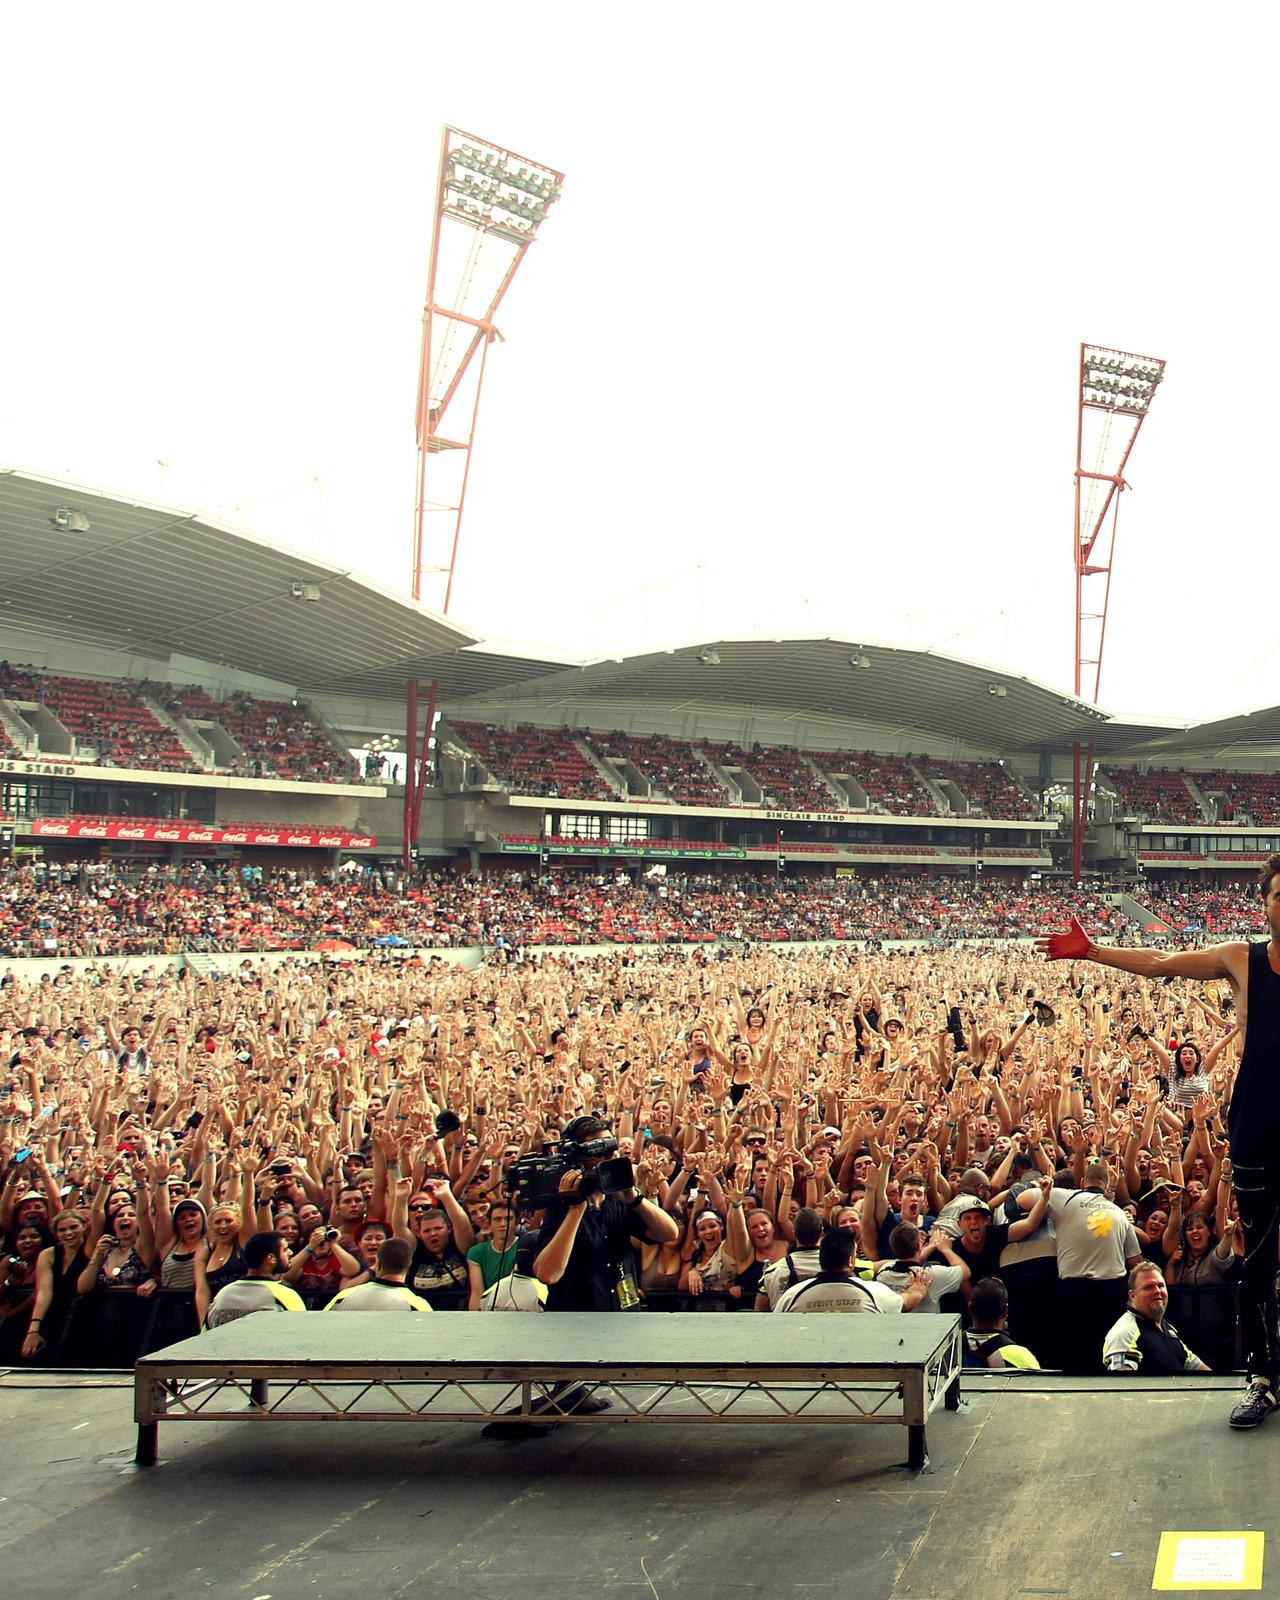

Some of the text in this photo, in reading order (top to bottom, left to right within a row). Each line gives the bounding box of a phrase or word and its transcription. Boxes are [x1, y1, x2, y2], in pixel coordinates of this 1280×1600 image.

[25, 764, 75, 775] STAND
[766, 811, 811, 820] SINCLAIR
[806, 1299, 862, 1309] EVENT STAFF
